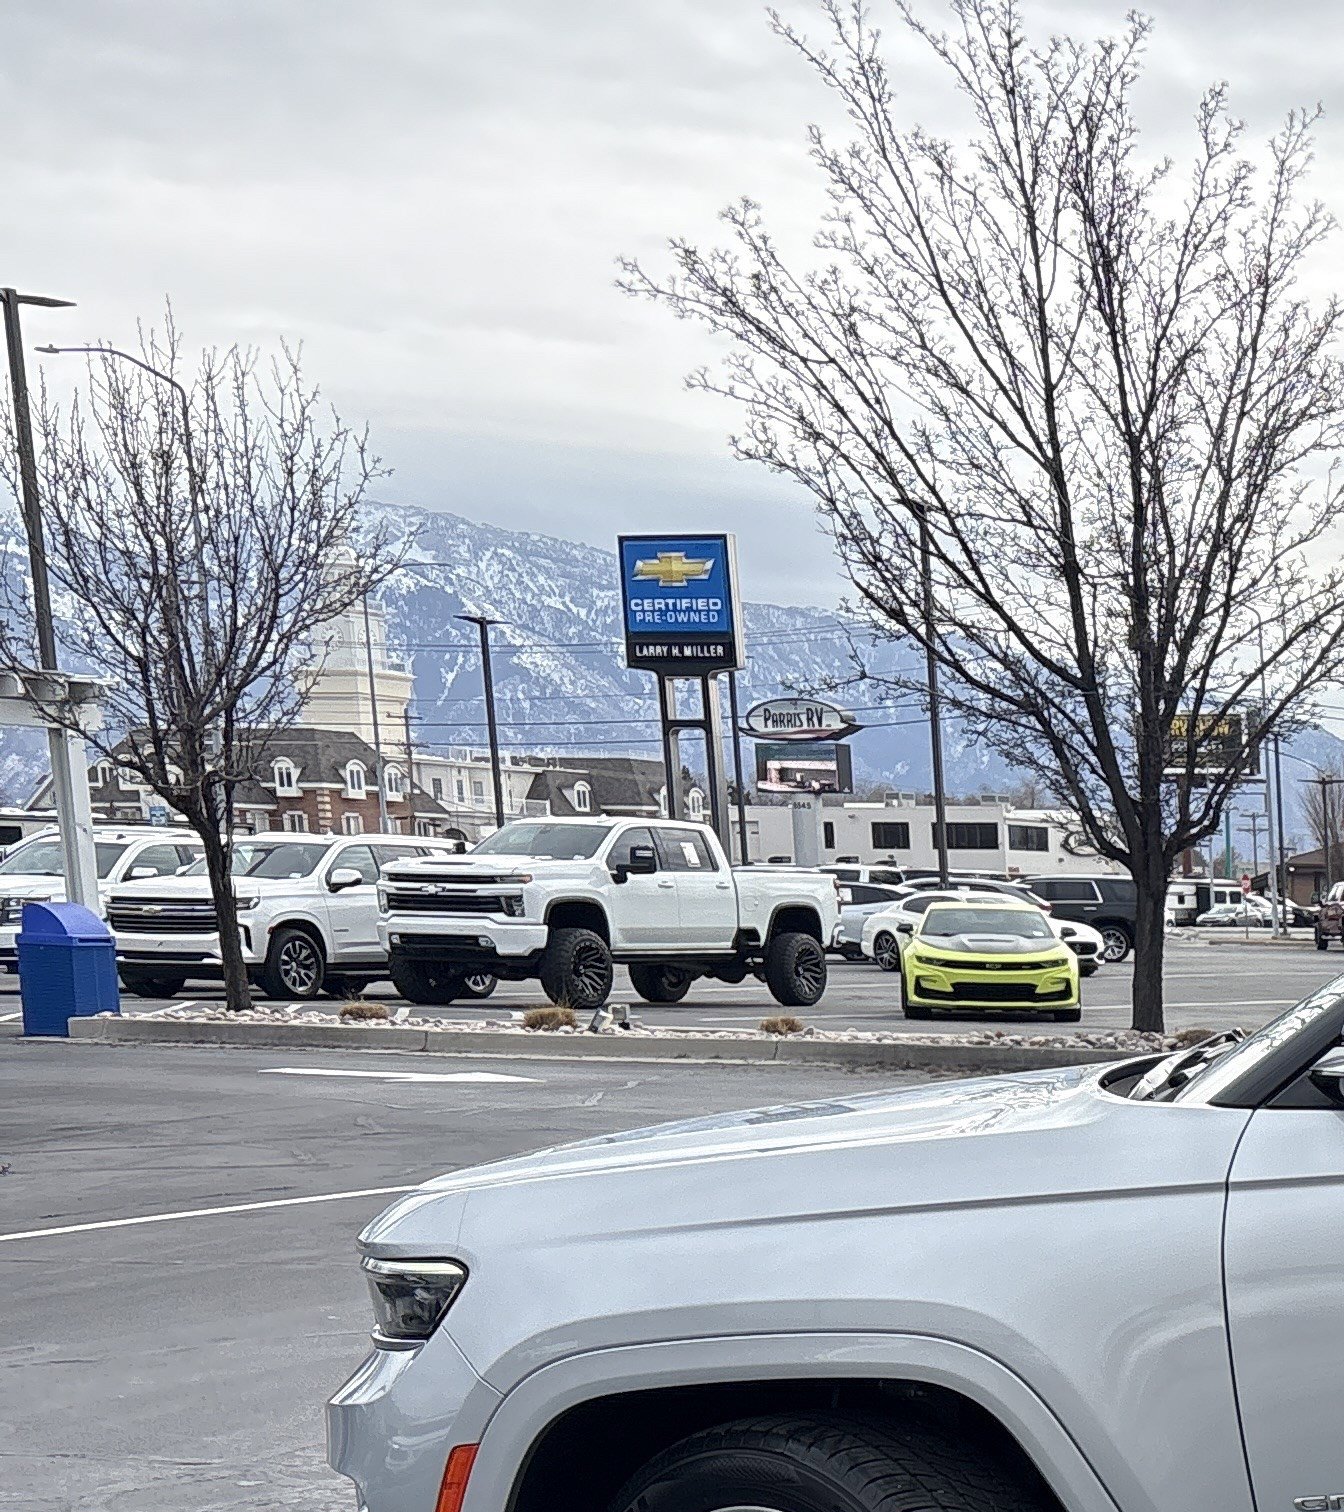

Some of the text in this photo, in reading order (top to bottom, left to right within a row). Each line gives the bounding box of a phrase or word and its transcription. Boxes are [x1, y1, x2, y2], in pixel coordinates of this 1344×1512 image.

[630, 598, 722, 611] CERTIFIED
[635, 611, 719, 623] PRE-OWNED
[635, 645, 669, 657] LARRY
[683, 645, 724, 657] MILLER
[805, 707, 824, 728] RV
